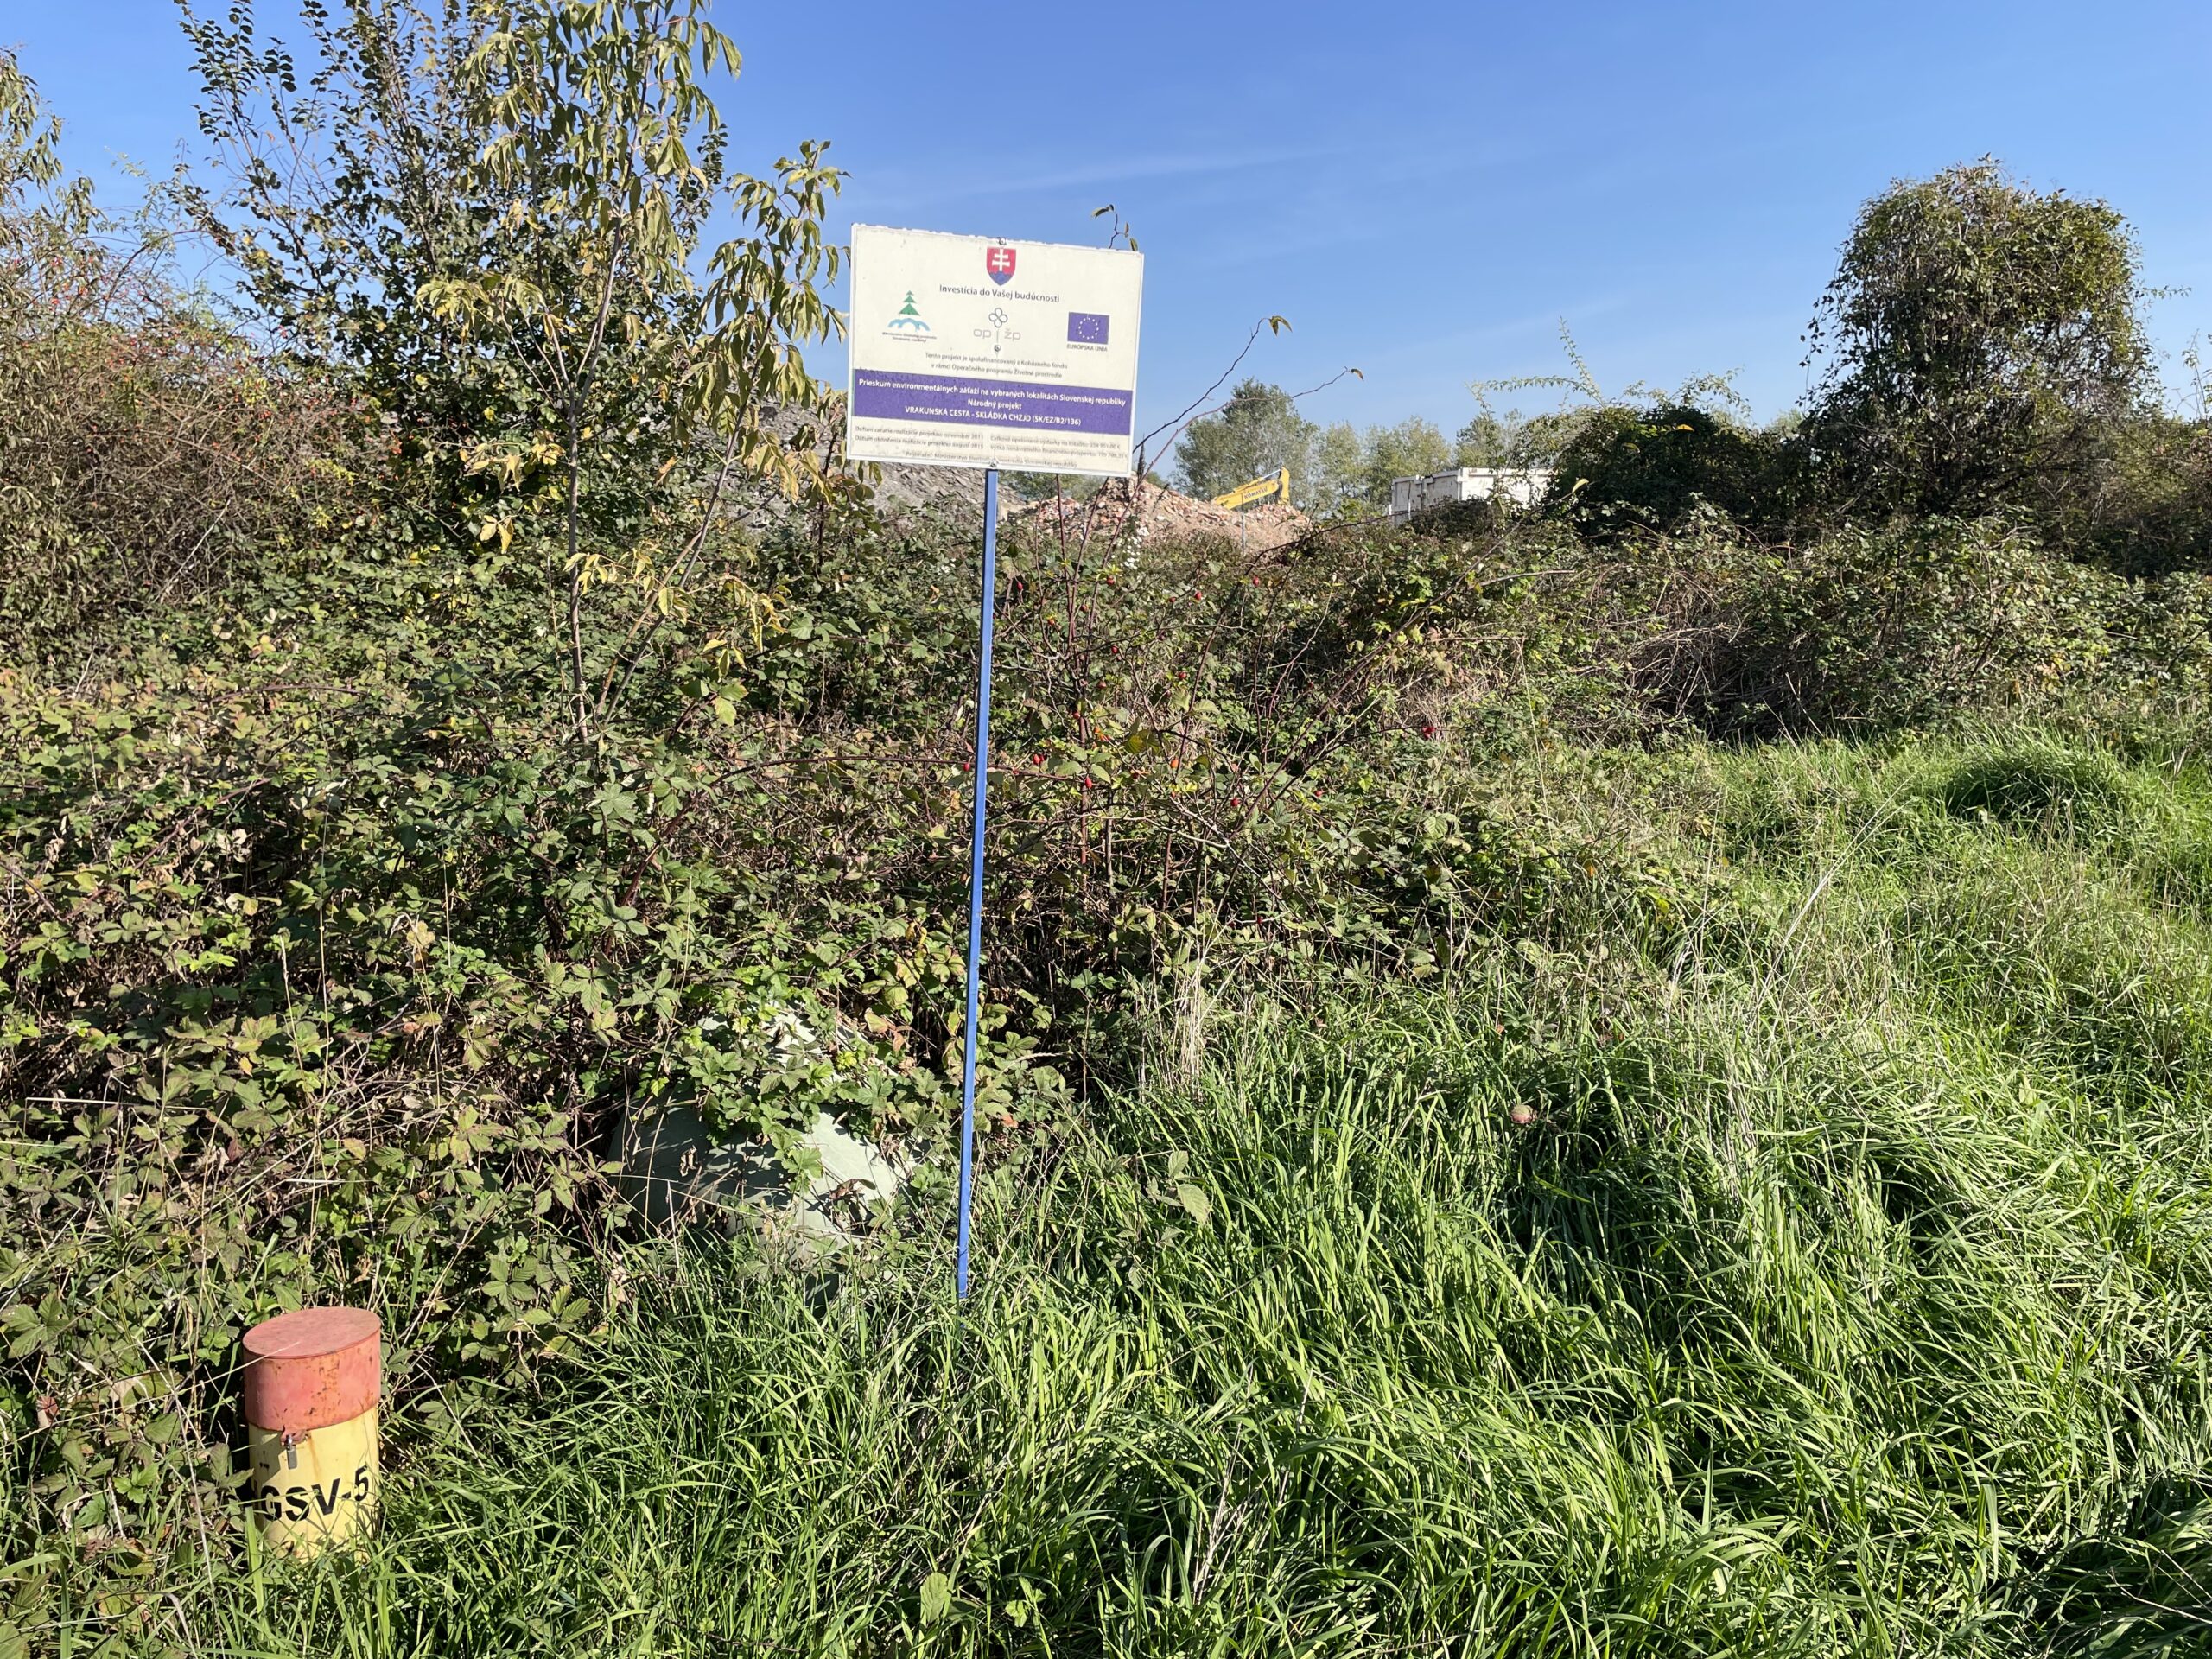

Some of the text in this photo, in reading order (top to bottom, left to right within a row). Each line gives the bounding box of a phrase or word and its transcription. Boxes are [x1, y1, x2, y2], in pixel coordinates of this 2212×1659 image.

[939, 284, 1060, 302] Investícia do Vašej budúcnosti
[858, 378, 891, 388] Prieskum
[892, 382, 958, 394] environmentálnych
[959, 385, 980, 395] záťaží
[990, 389, 1025, 399] vybraných
[1026, 391, 1058, 401] lokalitách
[1059, 394, 1094, 404] Slovenskej
[1095, 397, 1126, 408] republiky
[968, 398, 1022, 410] Národný projekt
[949, 409, 970, 417] CESTA
[976, 410, 1007, 420] SKLÁDKA
[1033, 416, 1081, 426] (SK/EZ/B2/136)
[261, 1465, 370, 1522] GSV-5
